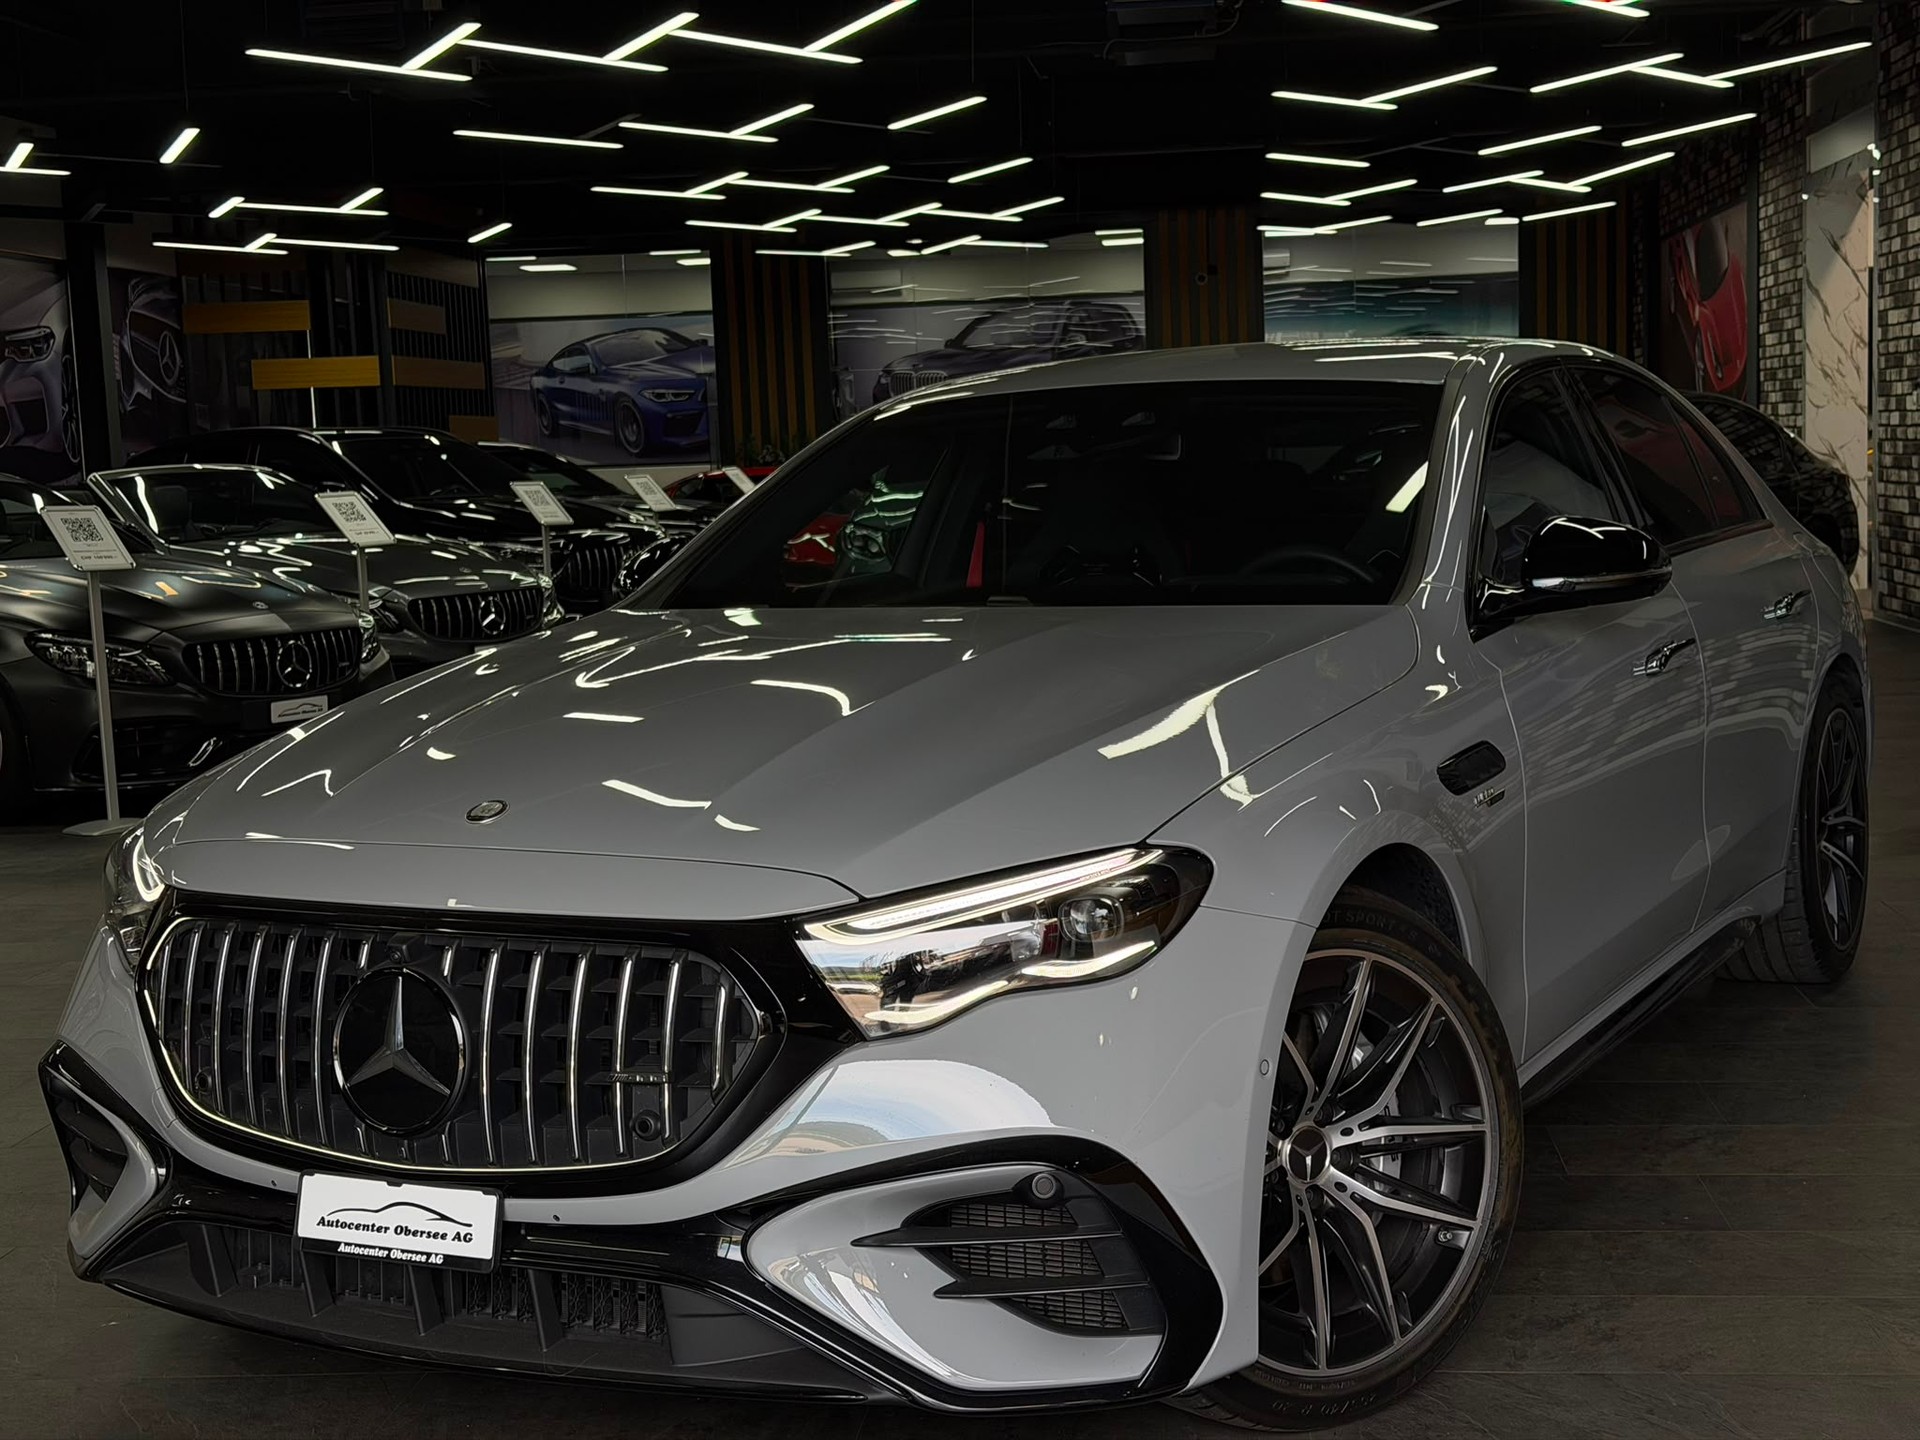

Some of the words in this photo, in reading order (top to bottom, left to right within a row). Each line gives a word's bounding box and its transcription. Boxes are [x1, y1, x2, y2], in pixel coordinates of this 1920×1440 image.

[1345, 909, 1397, 931] SPORT
[316, 1216, 390, 1234] Autocenter
[394, 1225, 448, 1240] Obersee
[451, 1231, 473, 1243] AG
[337, 1243, 389, 1259] Autocenter
[390, 1249, 427, 1263] Obersee
[428, 1254, 444, 1265] AG
